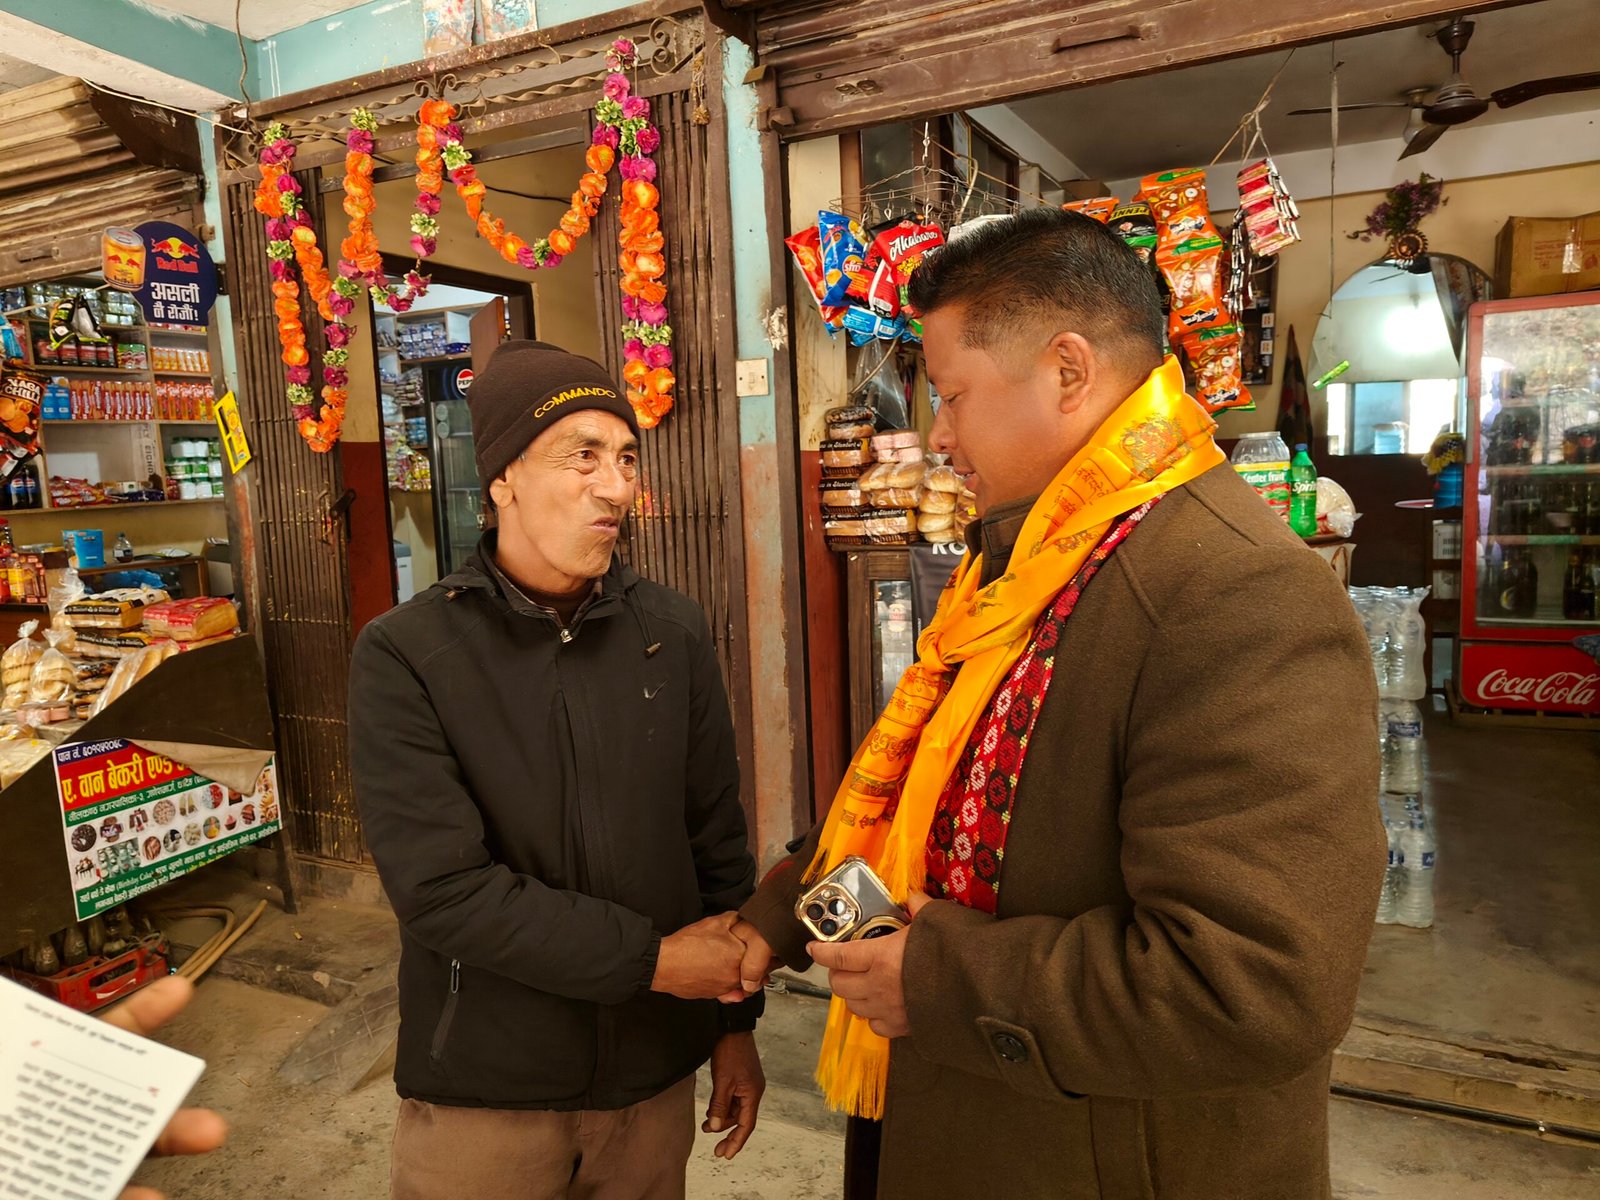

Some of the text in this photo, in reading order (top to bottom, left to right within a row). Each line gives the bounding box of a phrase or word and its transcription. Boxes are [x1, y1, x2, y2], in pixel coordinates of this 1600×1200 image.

[150, 281, 200, 304] असली
[152, 301, 165, 319] नै
[534, 386, 617, 418] COMMANDO
[1477, 668, 1600, 705] Coca-Cola
[61, 779, 77, 803] ए.
[78, 769, 106, 798] वान
[106, 752, 145, 790] बेकरी
